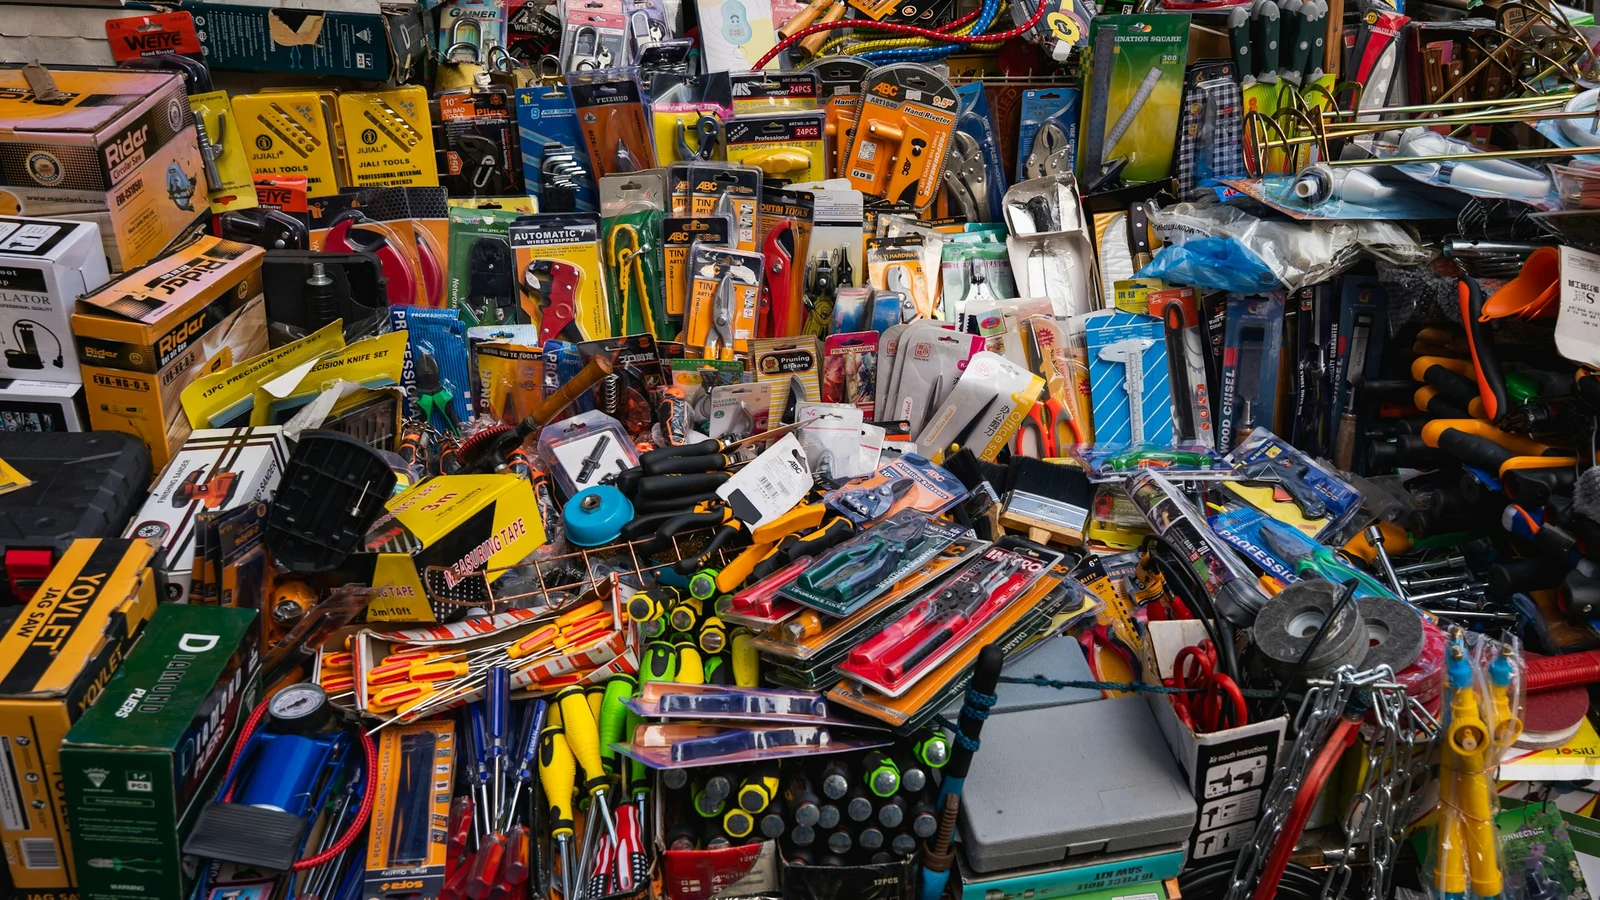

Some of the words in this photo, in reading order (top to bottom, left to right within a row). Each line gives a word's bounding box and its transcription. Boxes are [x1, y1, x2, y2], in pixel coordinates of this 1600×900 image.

[449, 8, 497, 18] GAINER
[123, 31, 182, 51] WEIYE
[790, 85, 812, 94] 24PCS
[872, 82, 898, 96] ABC
[444, 98, 459, 106] 10"
[596, 95, 628, 104] FEIZHUO
[870, 97, 898, 109] ART1040
[933, 96, 955, 108] 9.5"
[476, 107, 507, 117] Pliers
[904, 106, 923, 118] Hand
[923, 110, 952, 125] Riveter
[982, 115, 991, 130] VISE
[588, 130, 597, 148] SIZE:
[796, 127, 818, 136] 24PCS
[105, 124, 148, 169] Rider
[930, 134, 939, 148] TIMES
[252, 152, 280, 160] JIJIALI
[357, 145, 383, 154] JIJIALI
[113, 161, 131, 179] Circular
[131, 154, 142, 167] Saw
[280, 165, 308, 173] TOOLS
[383, 158, 410, 166] TOOLS
[449, 154, 459, 172] 250
[901, 157, 910, 176] ABC
[923, 159, 932, 177] SERVICE
[357, 171, 396, 181] PROFESSIONAL
[696, 181, 718, 191] ABC
[26, 194, 105, 206] www.manslanka.com
[257, 188, 291, 204] EIYE
[514, 230, 577, 241] AUTOMATIC
[579, 228, 591, 237] 7"
[526, 237, 580, 245] WIRESTRIPPER
[668, 231, 689, 241] ABC
[0, 268, 17, 277] oot
[161, 259, 228, 295] Rider
[451, 278, 460, 309] Network
[698, 282, 713, 290] TIN
[160, 312, 206, 358] Rider
[1329, 323, 1338, 358] GUARANTEE
[85, 347, 118, 358] Rider
[347, 352, 371, 365] KNIFE
[373, 350, 389, 358] SET
[781, 356, 810, 364] Pruning
[163, 353, 195, 385] EVA-HG-0.5
[203, 382, 224, 398] 13PC
[226, 357, 274, 384] PRECISION
[277, 344, 303, 359] KNIFE
[306, 334, 323, 345] SET
[783, 362, 808, 370] Shears
[93, 375, 150, 391] EVA-HG-0.5
[480, 369, 491, 408] HONG
[1222, 369, 1236, 415] CHISEL
[926, 424, 944, 444] Stainless
[942, 408, 955, 426] steel
[994, 411, 1022, 444] Office
[1220, 416, 1233, 454] WOOD
[787, 459, 803, 475] ABC
[157, 478, 177, 504] FINISHING
[173, 459, 190, 481] SANDER
[259, 460, 277, 491] SANDER
[896, 462, 923, 485] Aviation
[922, 480, 947, 499] Scissors
[922, 467, 946, 483] ABC
[421, 491, 457, 511] 3m
[444, 534, 501, 590] MEASURING
[500, 517, 526, 545] TAPE
[1088, 558, 1098, 568] 6"
[36, 587, 61, 608] JAG
[388, 586, 415, 597] TAPE
[32, 573, 107, 652] YOVLET
[371, 606, 411, 617] 3m/10ft
[17, 611, 46, 638] SAW
[78, 643, 123, 711] YOVLET
[138, 633, 220, 714] DIAMOND
[115, 688, 147, 718] PLIERS
[1208, 756, 1217, 764] Air
[1217, 752, 1236, 761] mouth
[1236, 745, 1268, 758] instructions
[131, 782, 149, 790] PCS
[373, 808, 384, 858] REPLACEMENT
[382, 751, 390, 780] HACKSAW
[381, 869, 407, 877] Quality
[1093, 871, 1114, 881] KIT
[1116, 866, 1143, 877] SAW
[110, 884, 145, 892] WARNING
[873, 877, 898, 886] 12PCS
[1076, 880, 1105, 891] HOLE
[1107, 875, 1140, 886] PIECE
